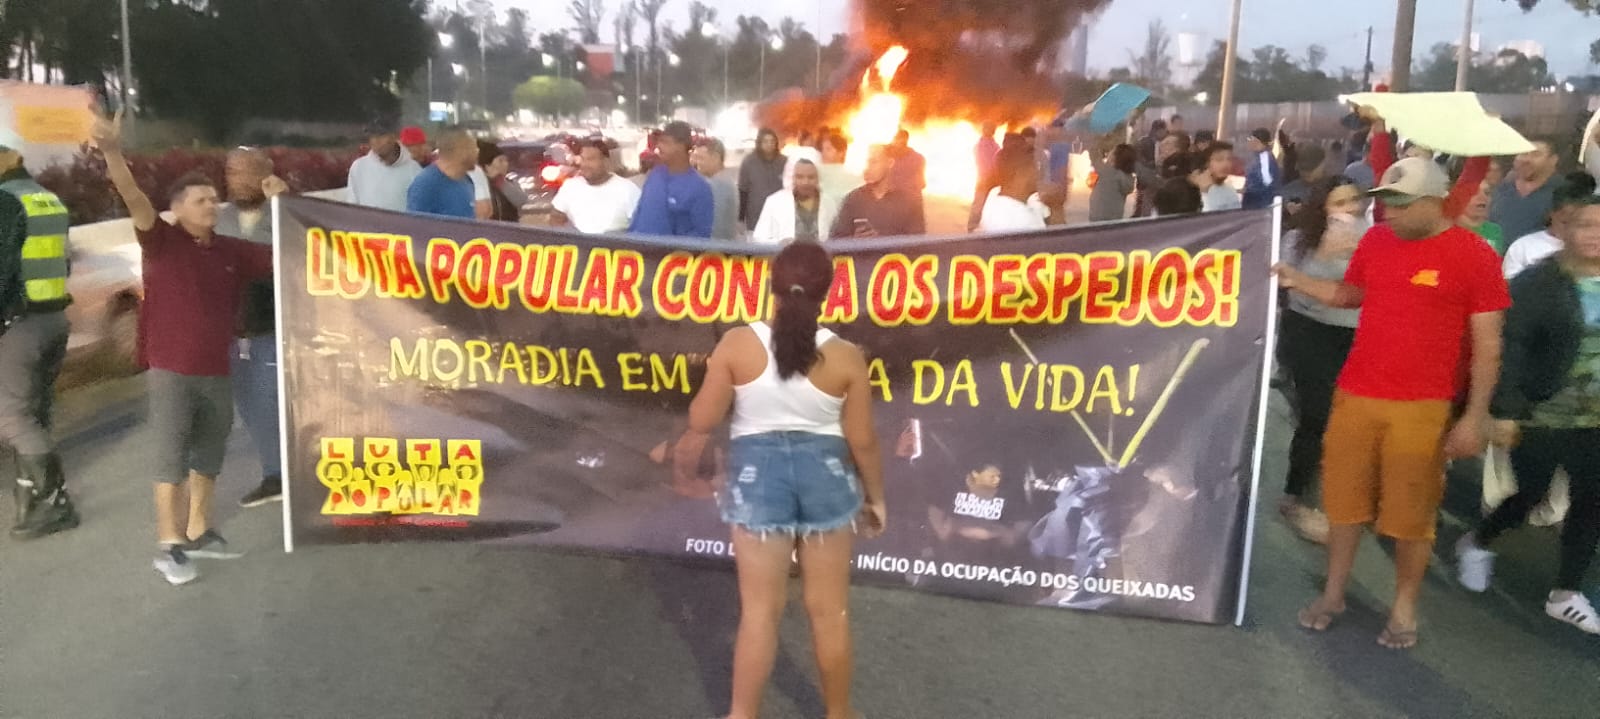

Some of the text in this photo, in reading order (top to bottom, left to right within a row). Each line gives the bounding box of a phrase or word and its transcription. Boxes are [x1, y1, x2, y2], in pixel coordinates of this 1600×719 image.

[307, 228, 1241, 327] LUTA POPULAR CONA OS DESPEJOS!
[388, 337, 605, 389] MORADIA
[617, 352, 692, 394] EM
[912, 359, 979, 407] DA
[1000, 362, 1140, 416] VIDA!
[327, 442, 476, 461] LUTA
[330, 486, 473, 513] POPULAR
[685, 538, 724, 555] FOTO
[857, 552, 909, 574] INÍCIO
[913, 560, 938, 576] DA
[941, 562, 1036, 587] OCUPAÇÃO
[1040, 573, 1080, 590] DOS
[1083, 576, 1195, 602] QUEIXADAS
